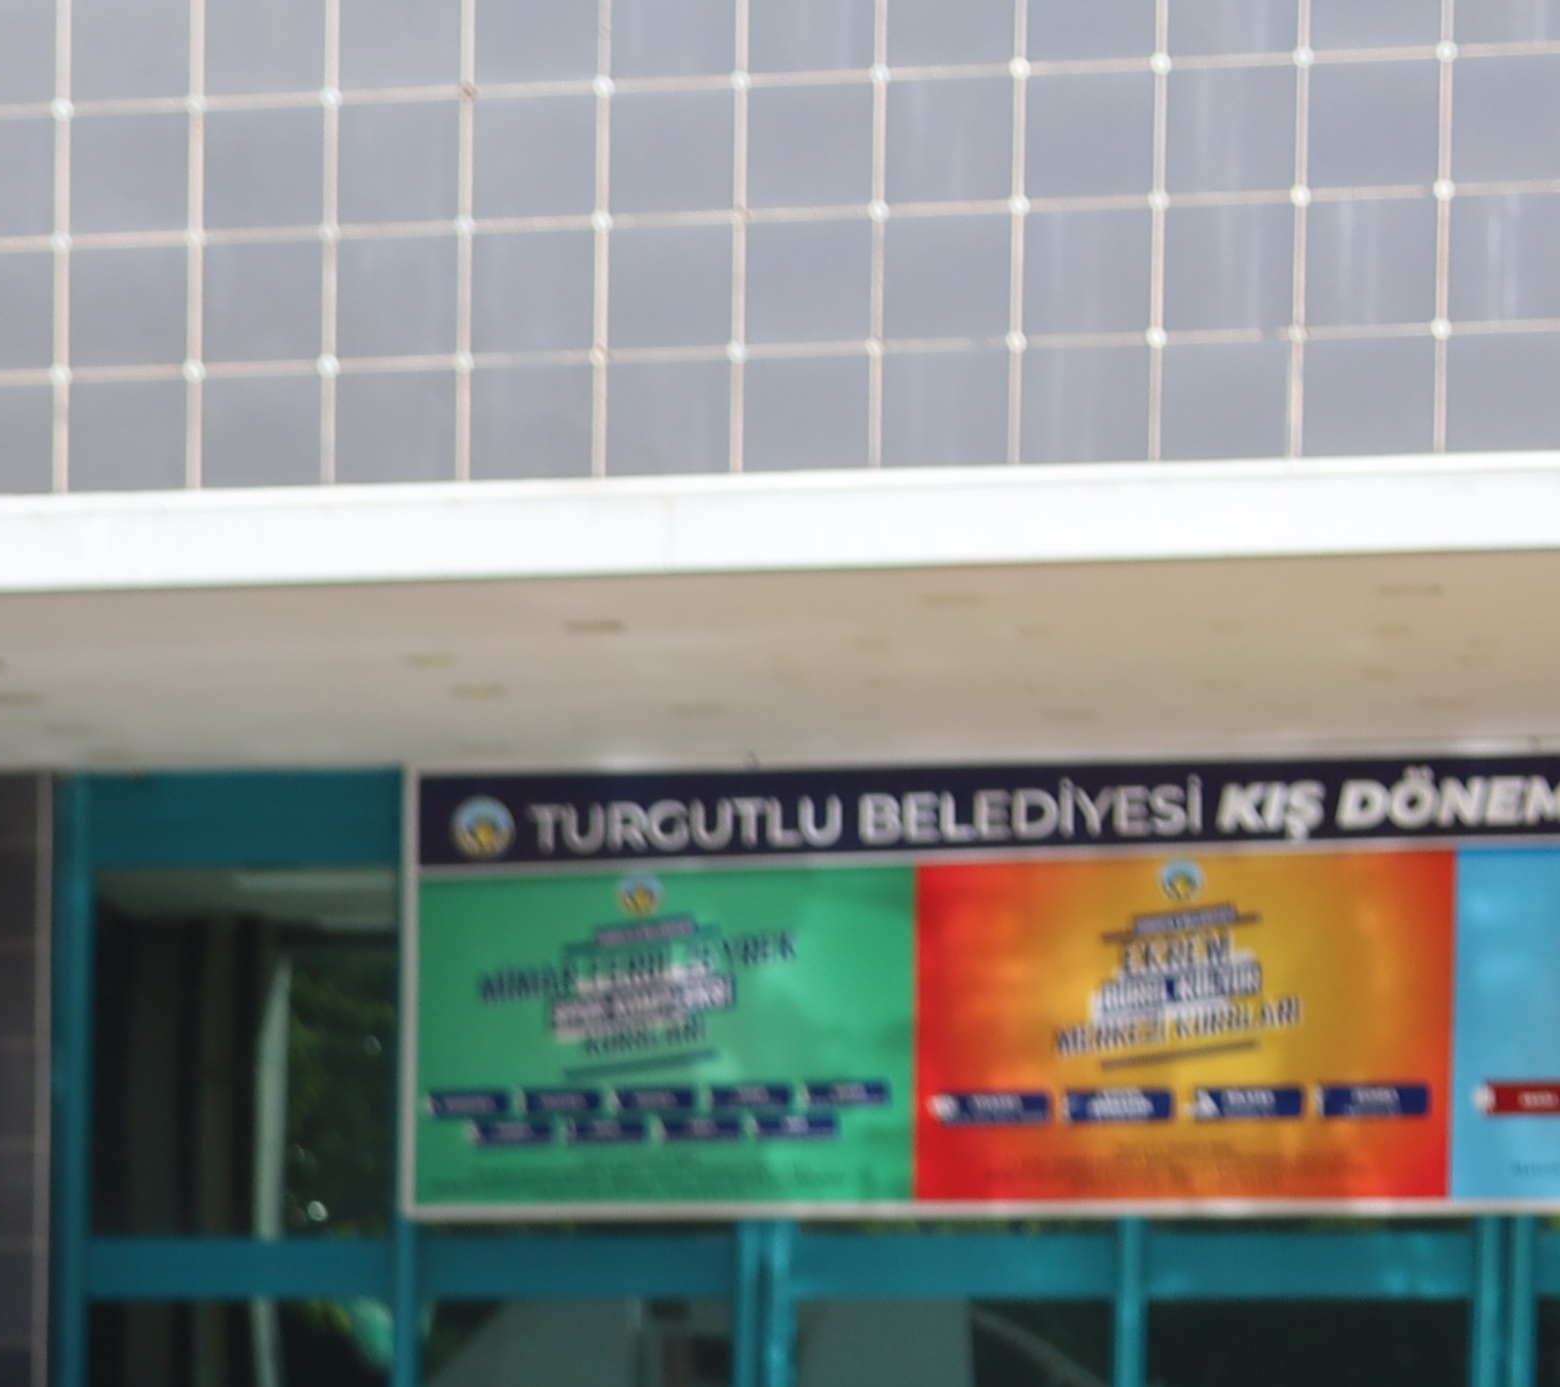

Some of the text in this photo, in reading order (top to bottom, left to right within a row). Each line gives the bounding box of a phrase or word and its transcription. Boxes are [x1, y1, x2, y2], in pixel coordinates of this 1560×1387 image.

[526, 793, 843, 855] TURGUTLU
[858, 772, 1204, 846] BELEDİYESİ
[1215, 778, 1327, 843] KIŞ
